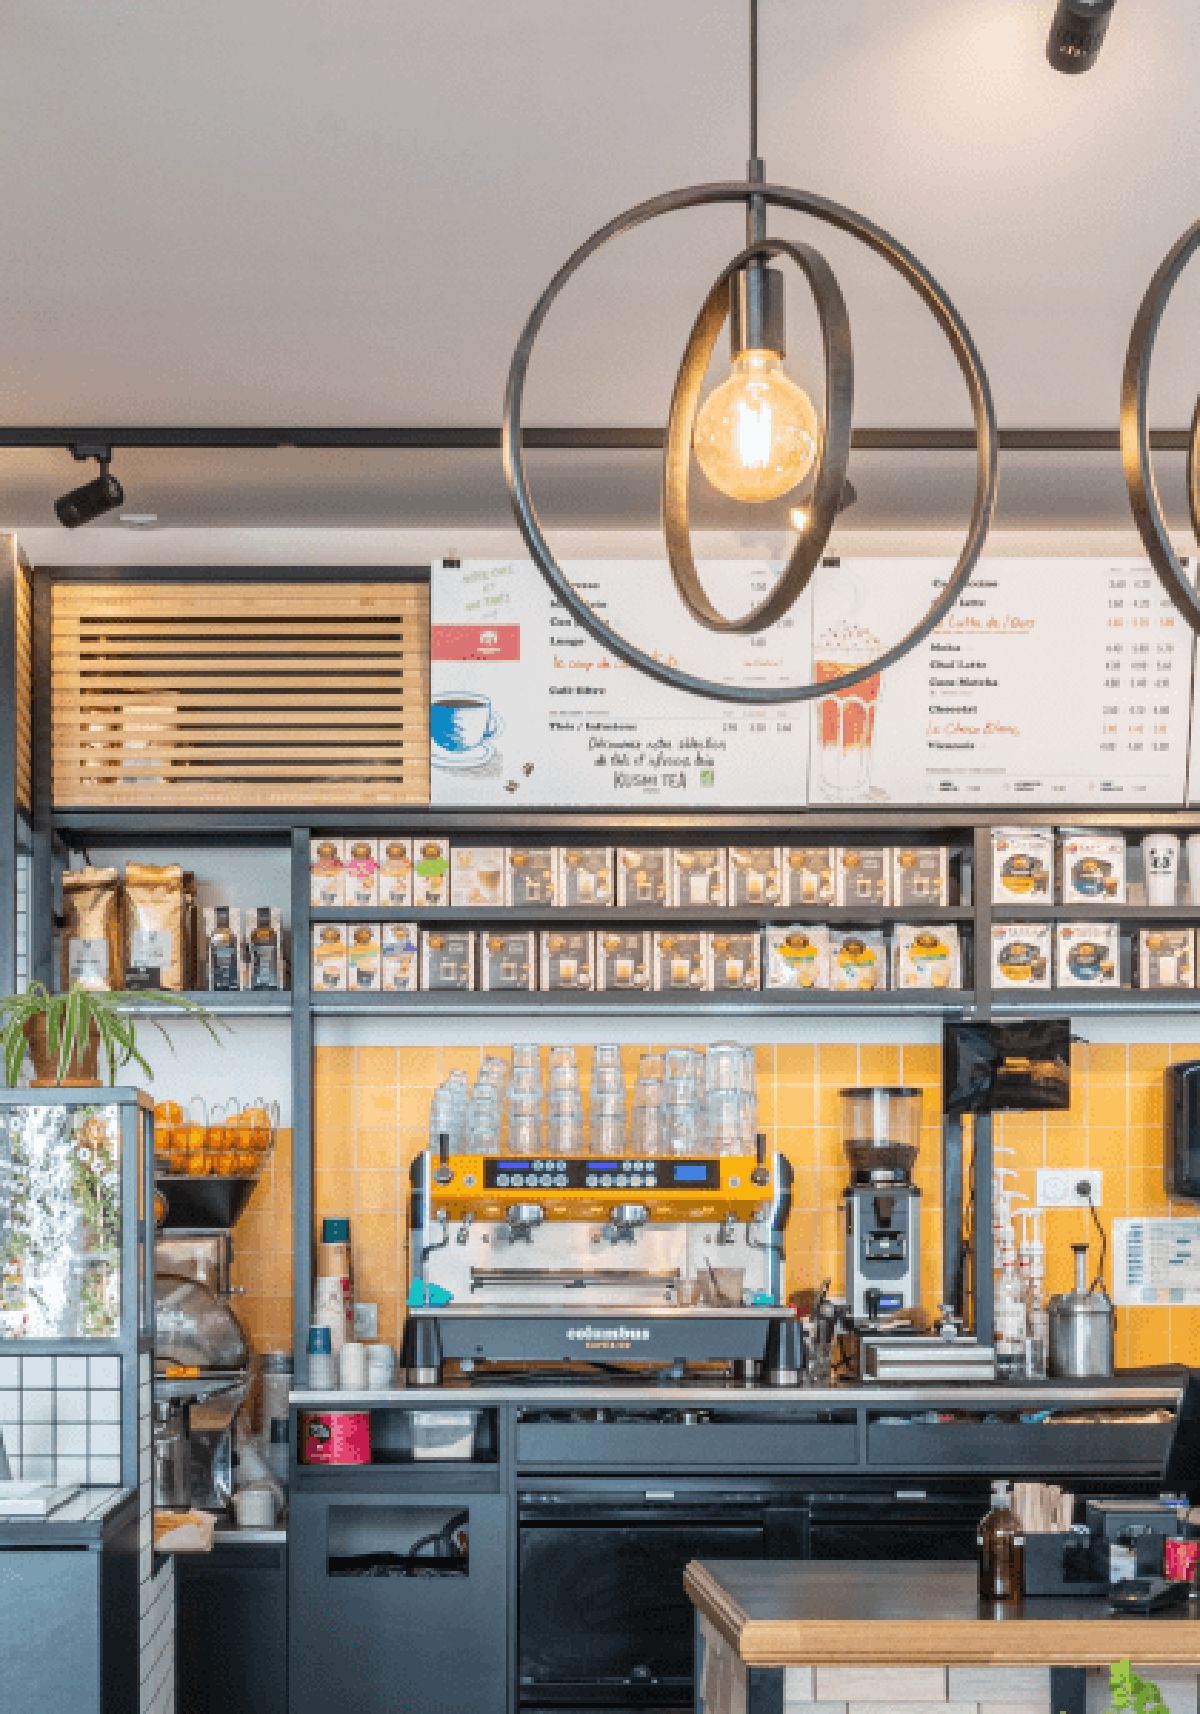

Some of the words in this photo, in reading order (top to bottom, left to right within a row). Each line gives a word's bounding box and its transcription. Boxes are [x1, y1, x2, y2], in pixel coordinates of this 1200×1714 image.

[613, 771, 658, 790] KUSMI
[661, 772, 687, 790] TEA
[566, 1325, 651, 1341] columbus
